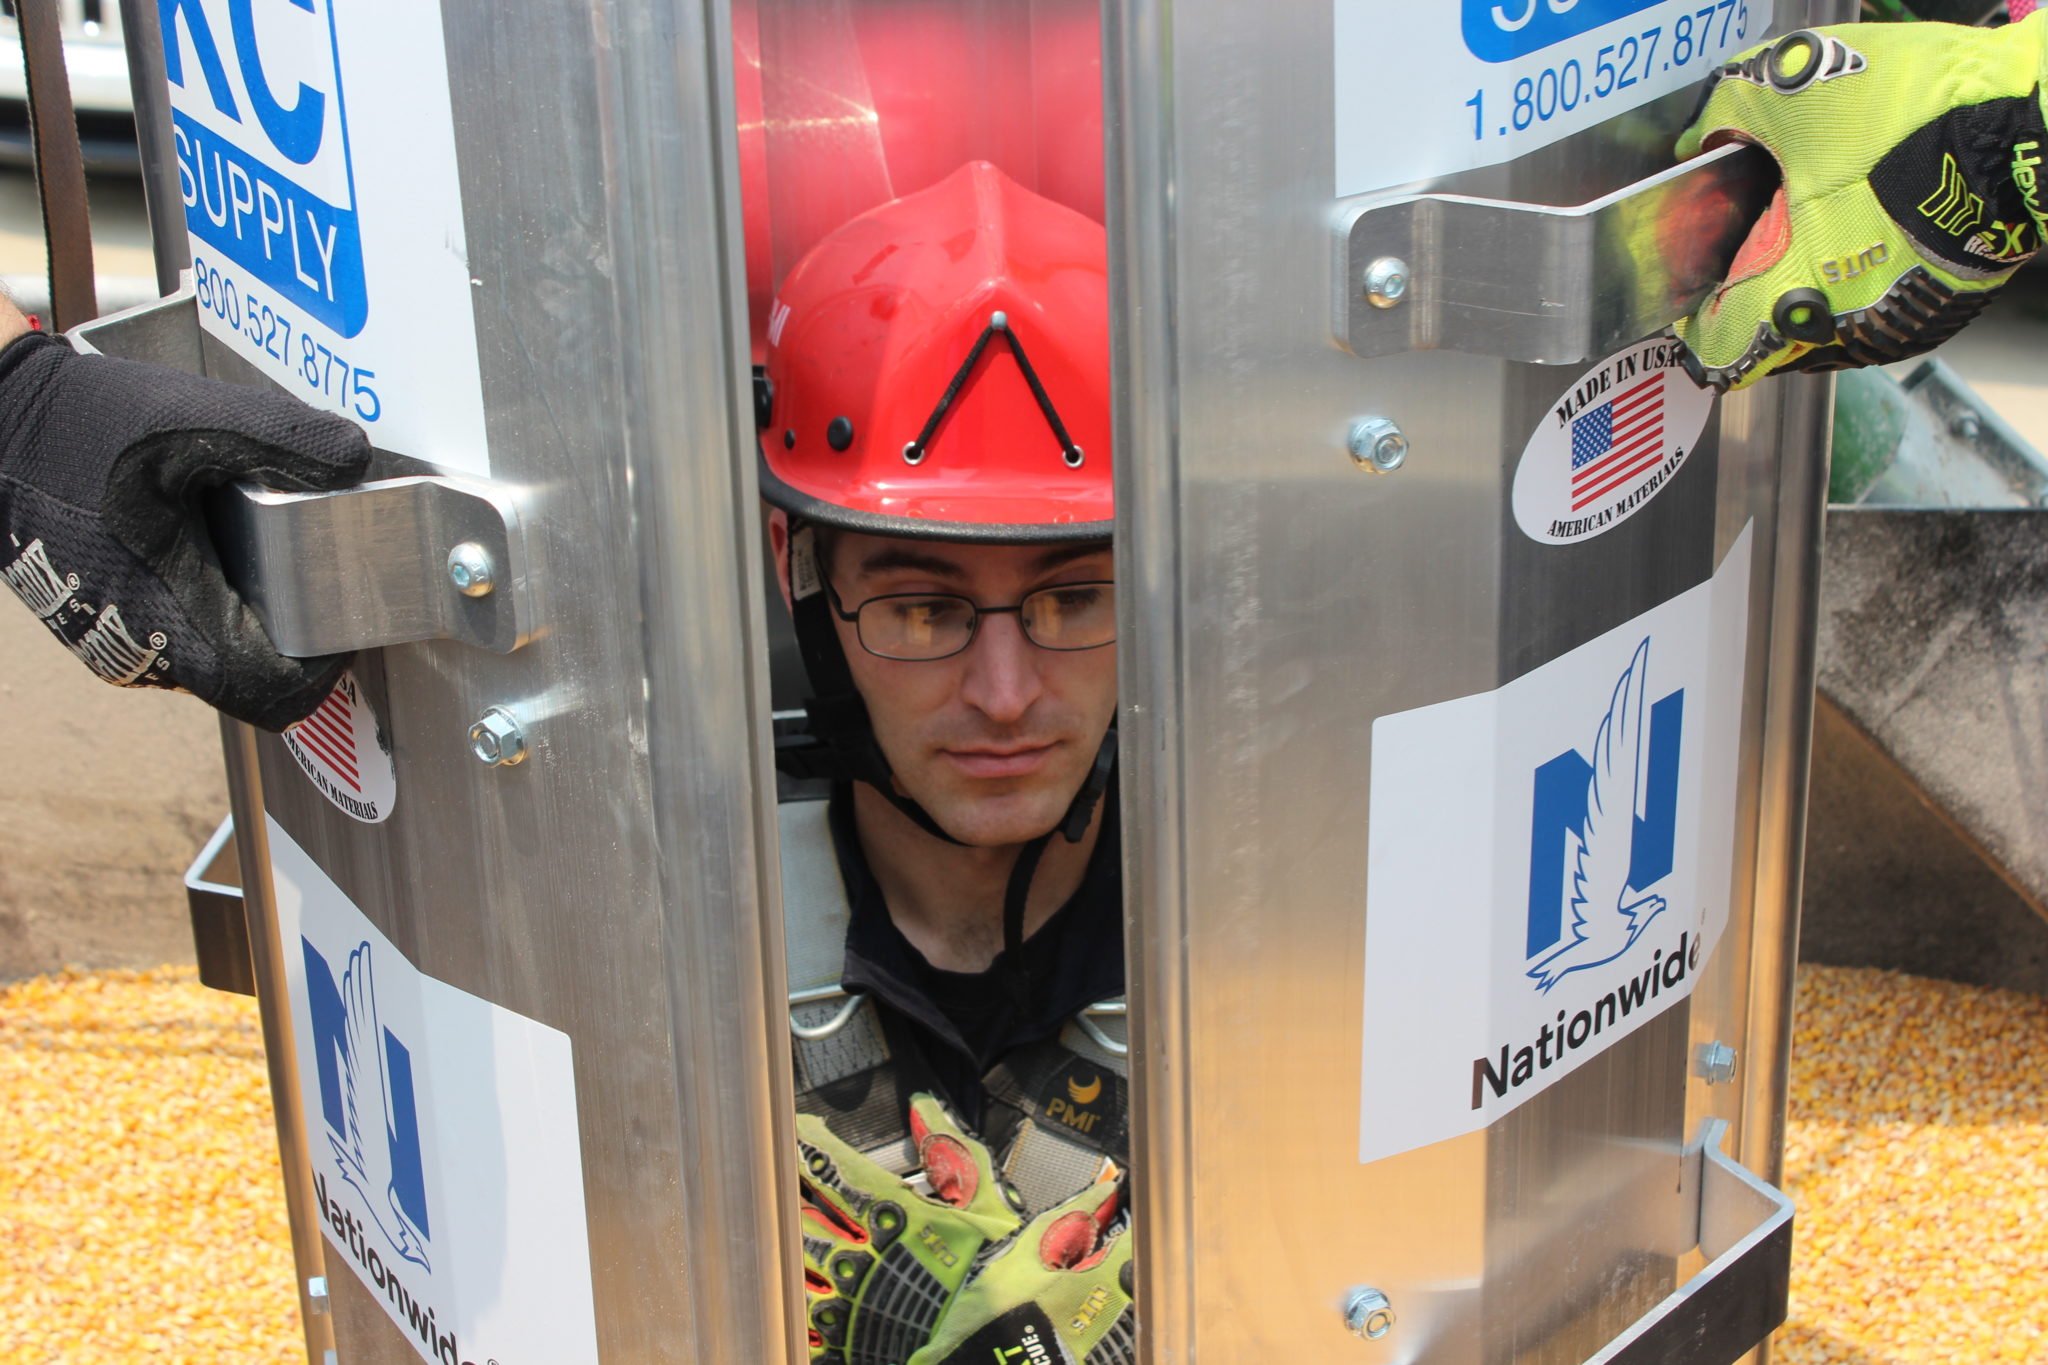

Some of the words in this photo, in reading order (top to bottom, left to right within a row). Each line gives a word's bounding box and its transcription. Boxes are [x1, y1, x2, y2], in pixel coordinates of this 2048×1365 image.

[1465, 0, 1748, 140] 1.800.527.8775
[173, 123, 338, 302] SUPPLY
[195, 257, 381, 422] 800.527.8775
[1555, 370, 1611, 429] MADE
[1616, 353, 1638, 385] IN
[1546, 506, 1613, 538] AMERICAN
[1616, 446, 1685, 518] MATERIALS
[330, 783, 378, 820] MATERIALS
[1471, 931, 1700, 1111] Nationwide
[312, 1167, 476, 1365] Nationwid
